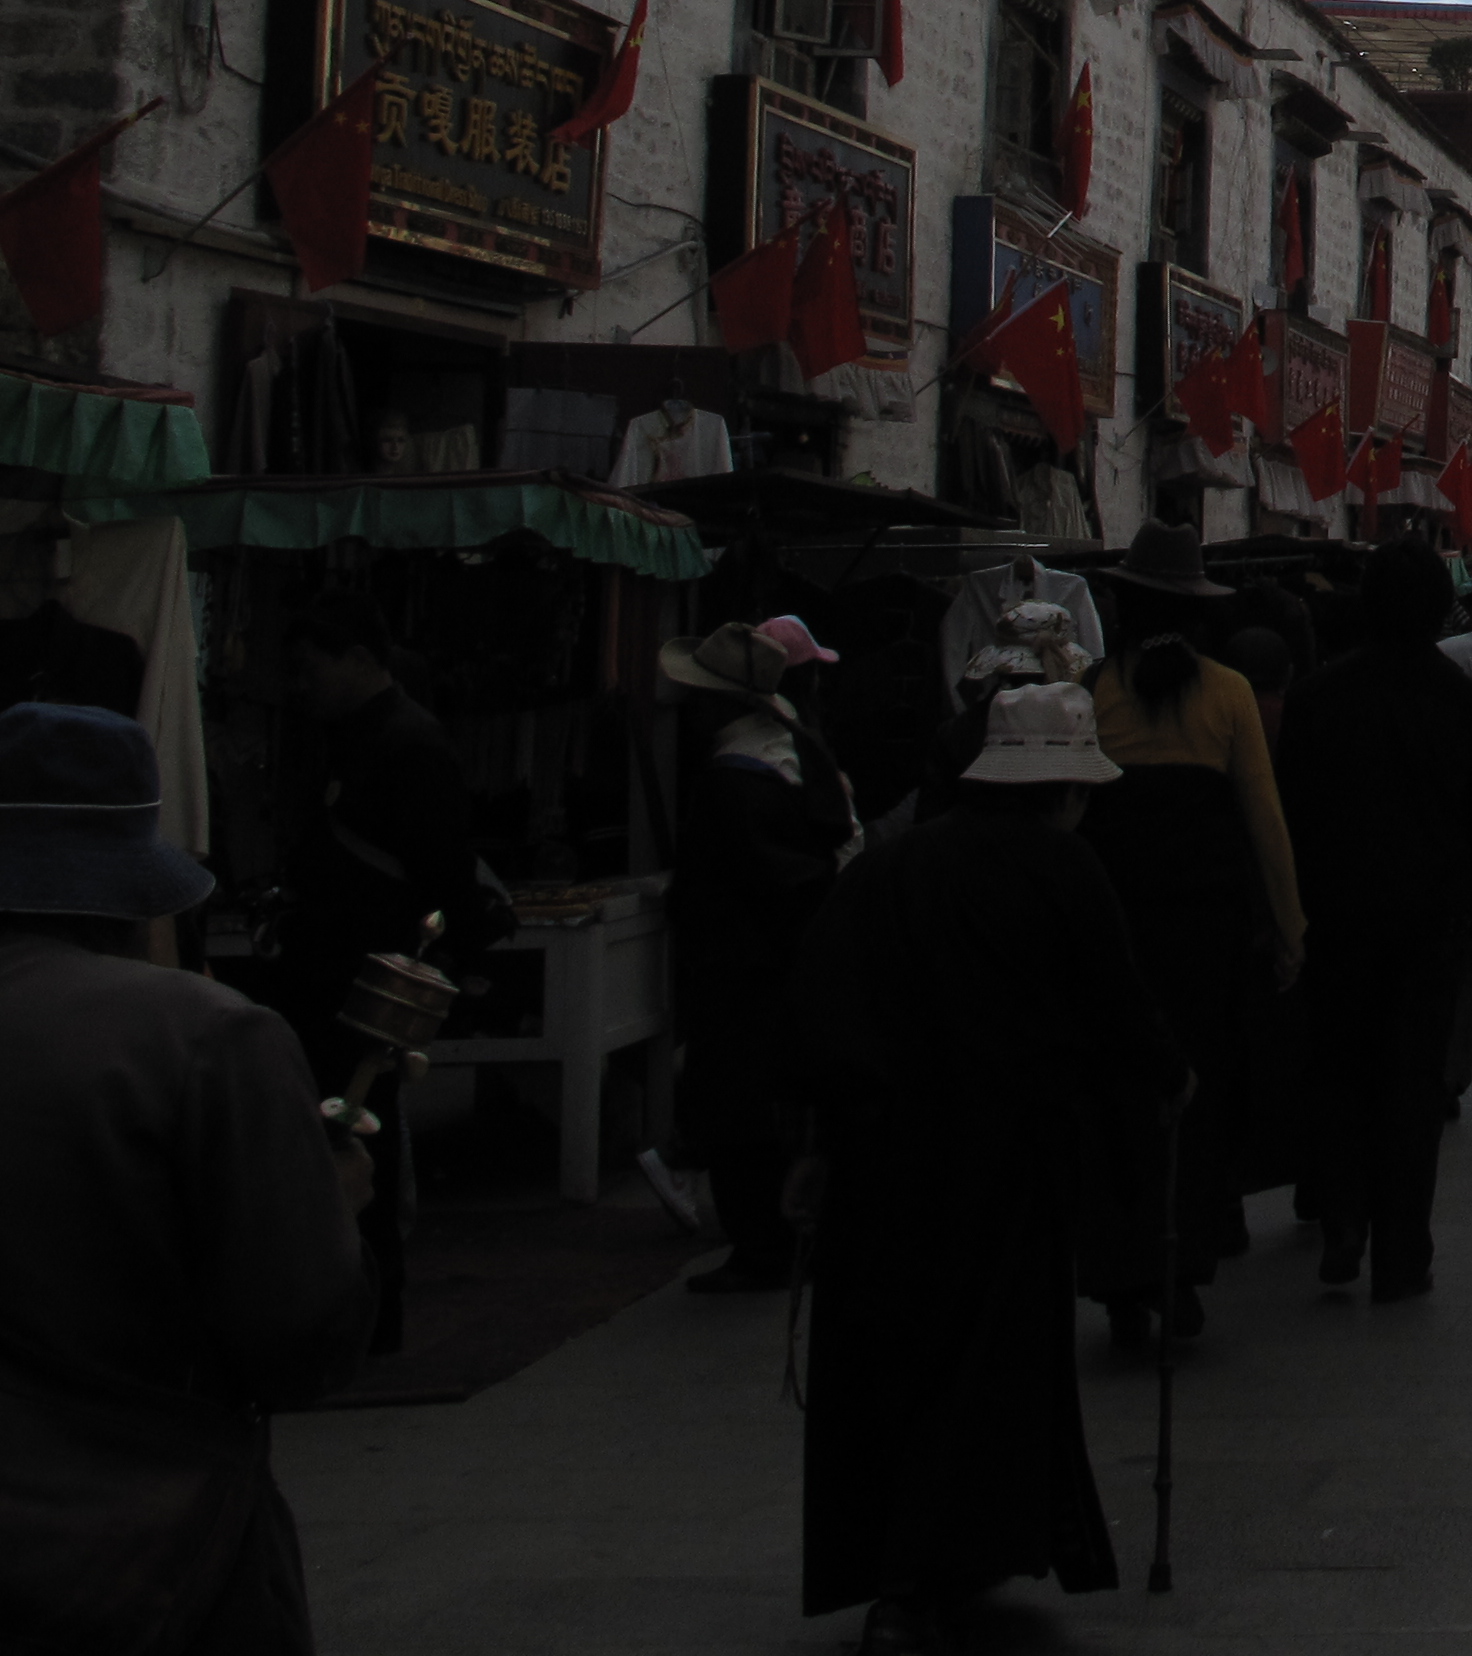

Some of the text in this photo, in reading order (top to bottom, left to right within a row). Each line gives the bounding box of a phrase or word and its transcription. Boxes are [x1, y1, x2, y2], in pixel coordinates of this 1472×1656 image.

[374, 70, 572, 194] 贡嘎服装店
